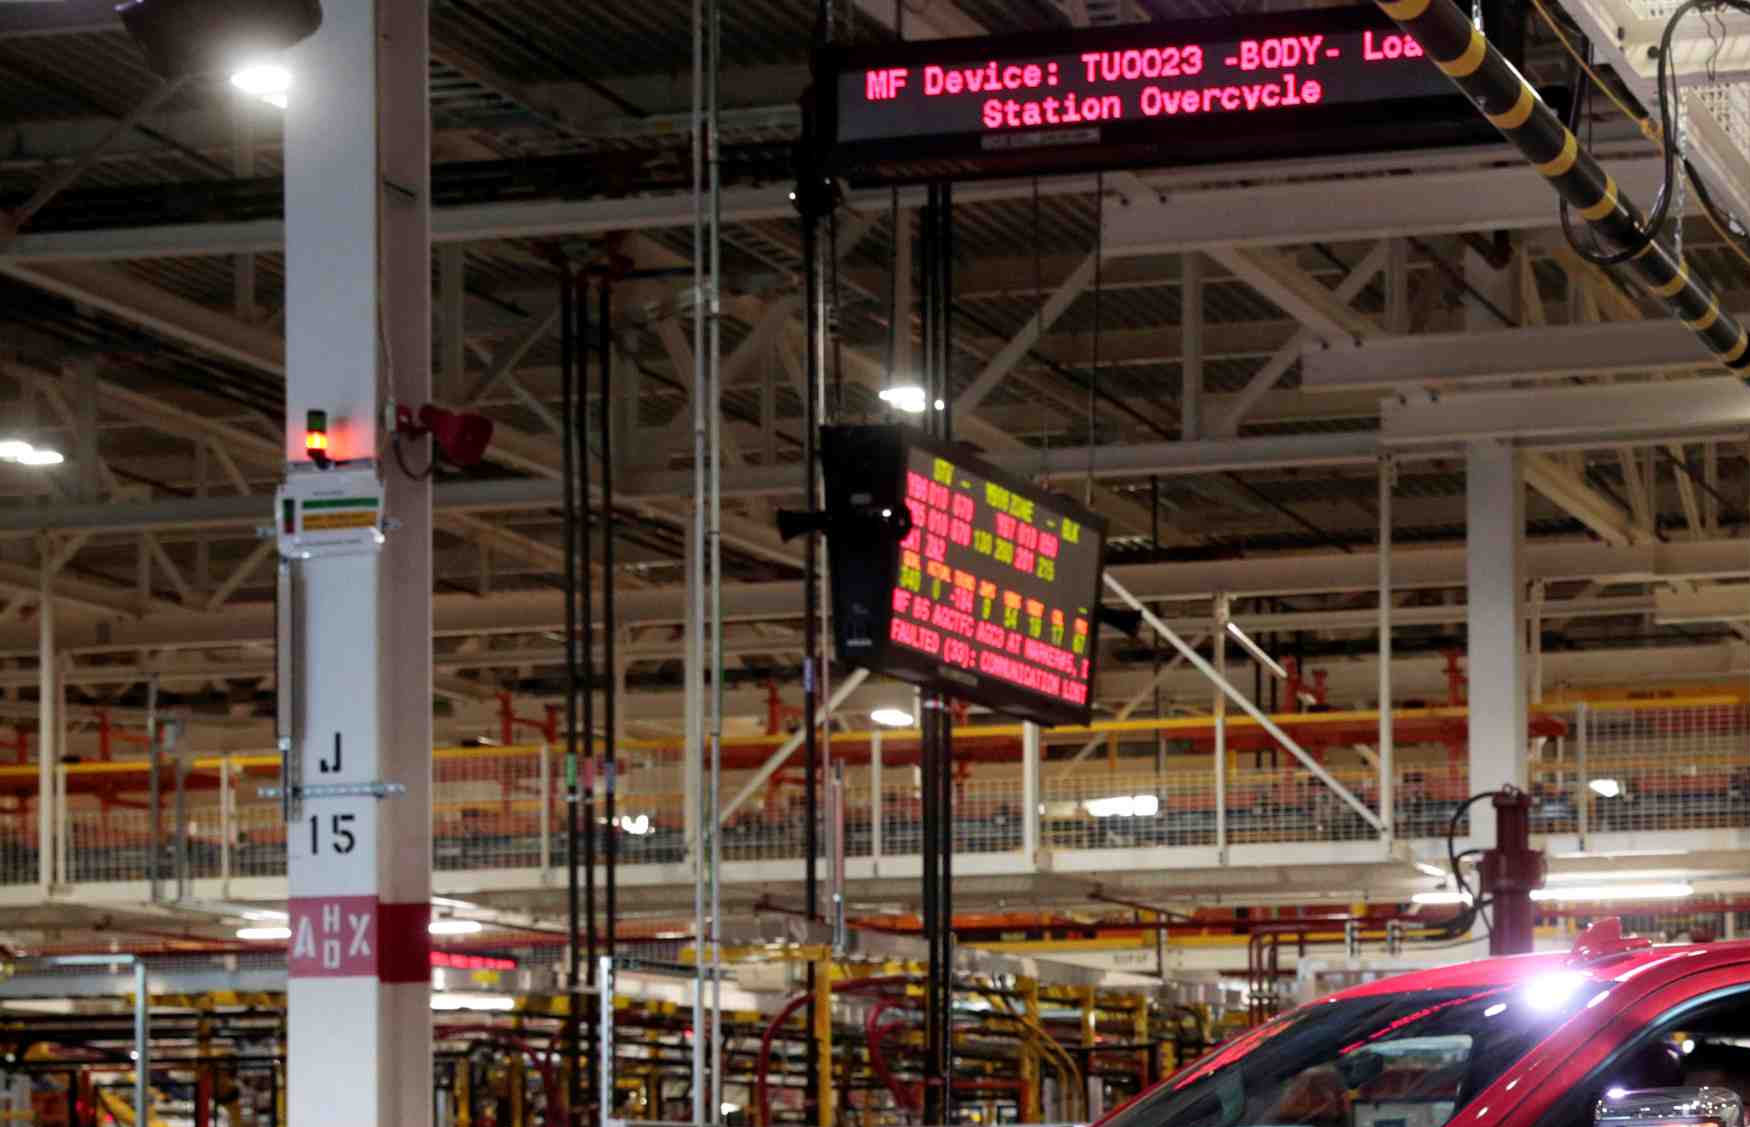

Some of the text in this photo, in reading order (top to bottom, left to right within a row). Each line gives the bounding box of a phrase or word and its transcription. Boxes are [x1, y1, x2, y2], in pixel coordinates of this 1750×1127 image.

[866, 68, 907, 101] MF
[923, 61, 1060, 98] Device:
[1224, 35, 1339, 72] -BODY-
[982, 78, 1321, 129] Station Overcycle
[320, 733, 341, 772] J
[309, 814, 355, 854] 15
